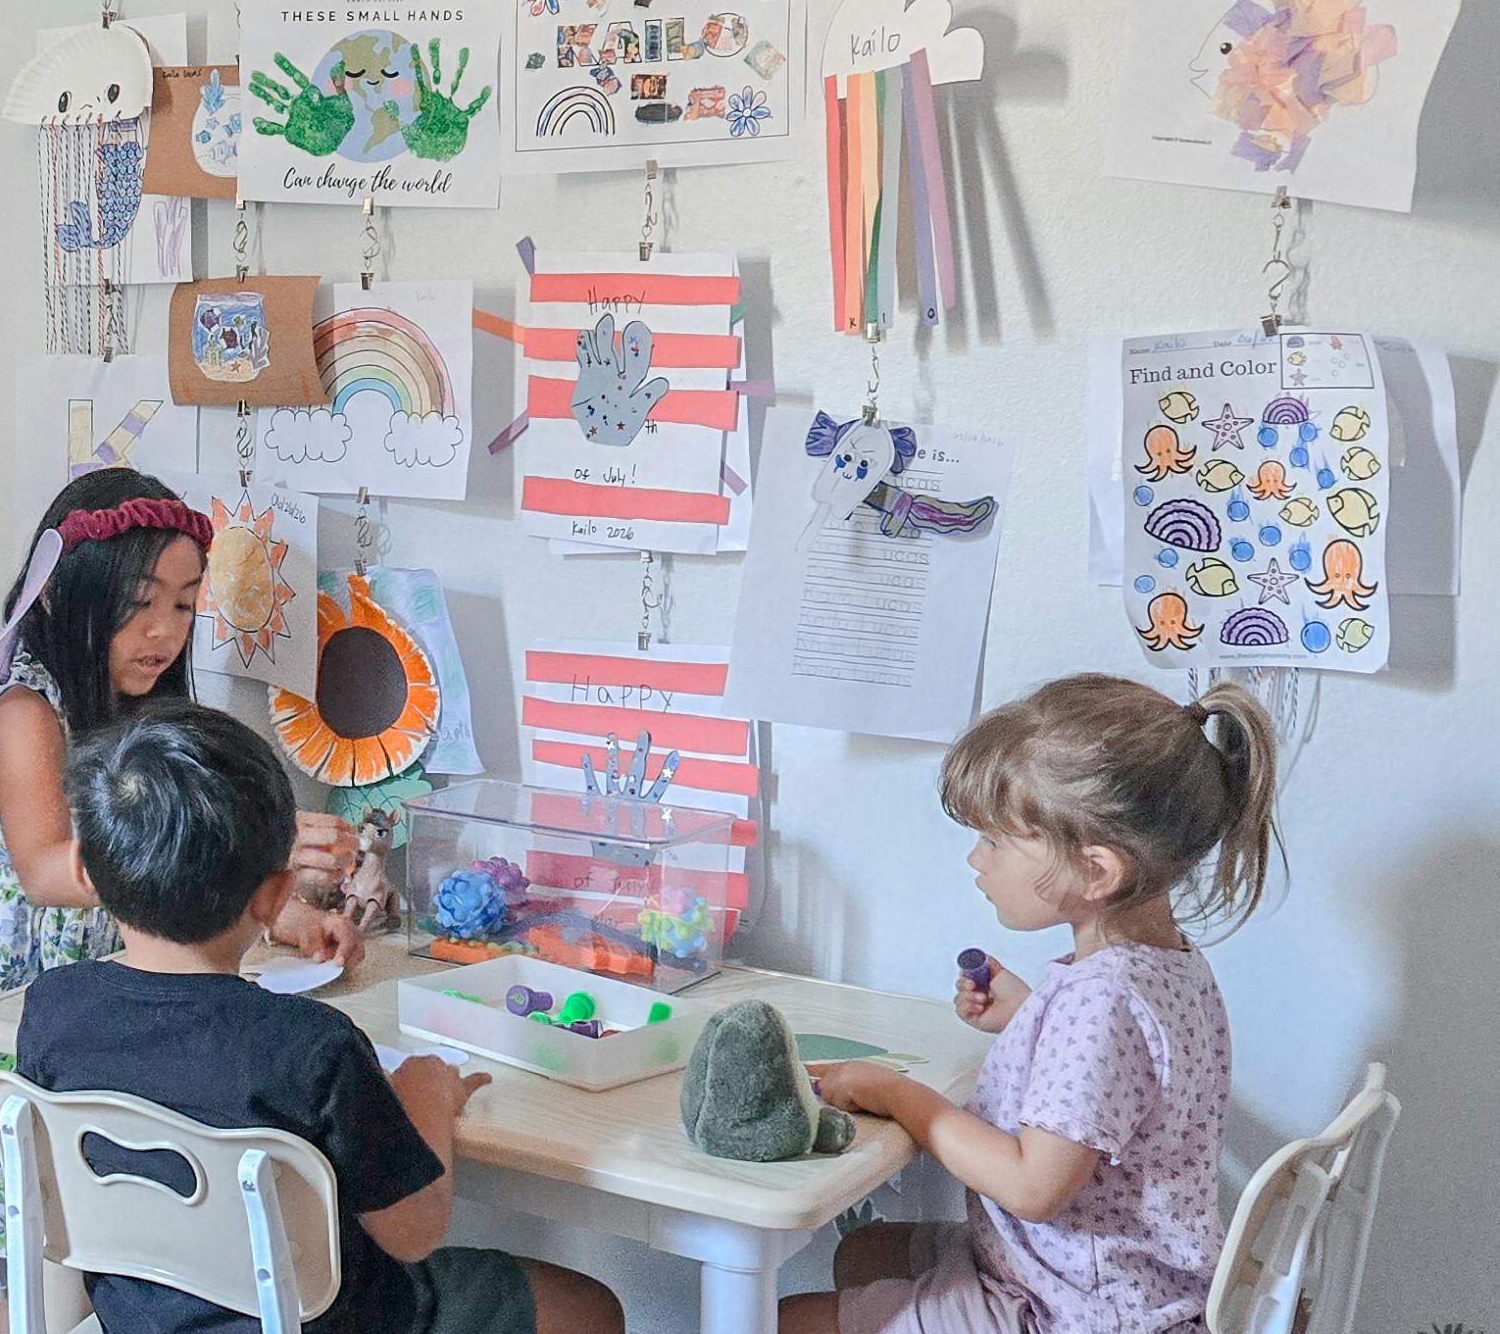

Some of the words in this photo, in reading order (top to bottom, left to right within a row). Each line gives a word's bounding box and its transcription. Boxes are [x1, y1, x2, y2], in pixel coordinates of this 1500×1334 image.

[281, 10, 338, 22] THESE
[346, 9, 401, 22] SMALL
[407, 9, 464, 22] HANDS
[556, 12, 749, 69] KAILO
[283, 166, 313, 191] Can
[316, 163, 368, 199] change
[369, 164, 398, 191] the
[401, 169, 453, 195] world
[586, 286, 647, 316] Happy
[1129, 365, 1173, 385] Find
[1176, 362, 1215, 380] and
[1219, 359, 1278, 377] Color
